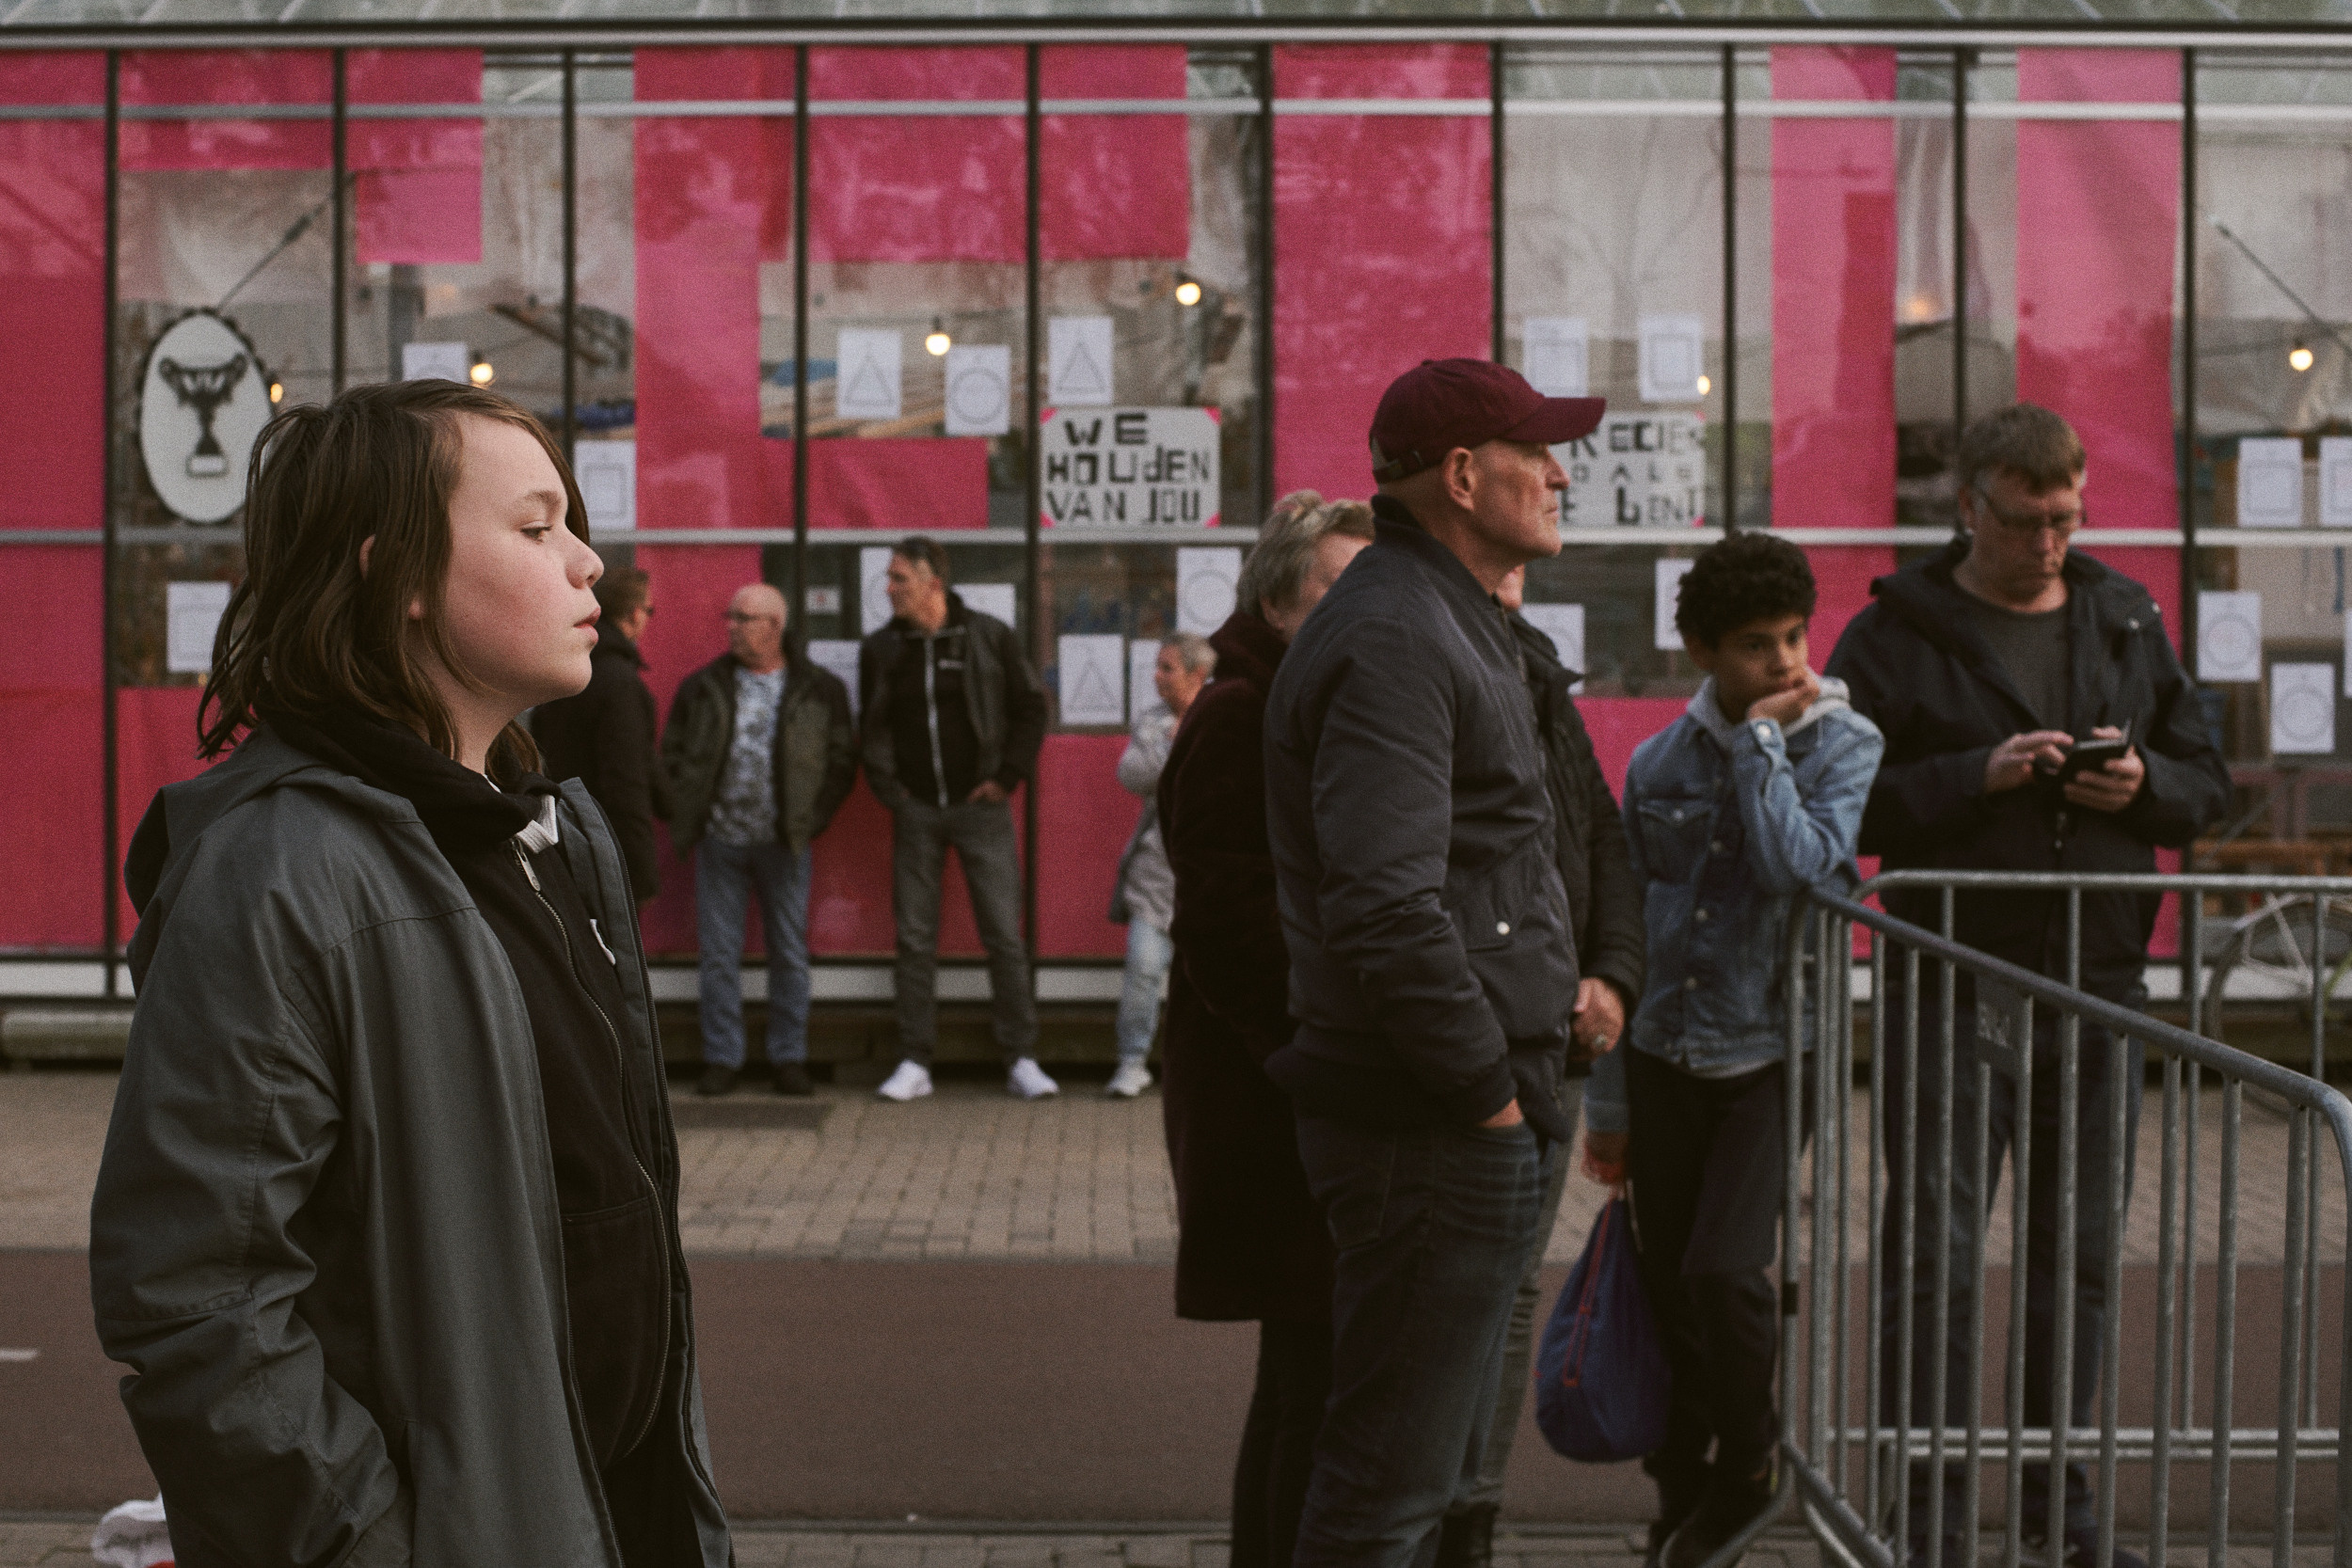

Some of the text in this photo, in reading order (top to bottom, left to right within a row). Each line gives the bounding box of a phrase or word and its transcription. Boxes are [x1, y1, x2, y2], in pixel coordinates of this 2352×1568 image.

[1064, 413, 1147, 446] WE
[1046, 488, 1200, 523] VAN JOU
